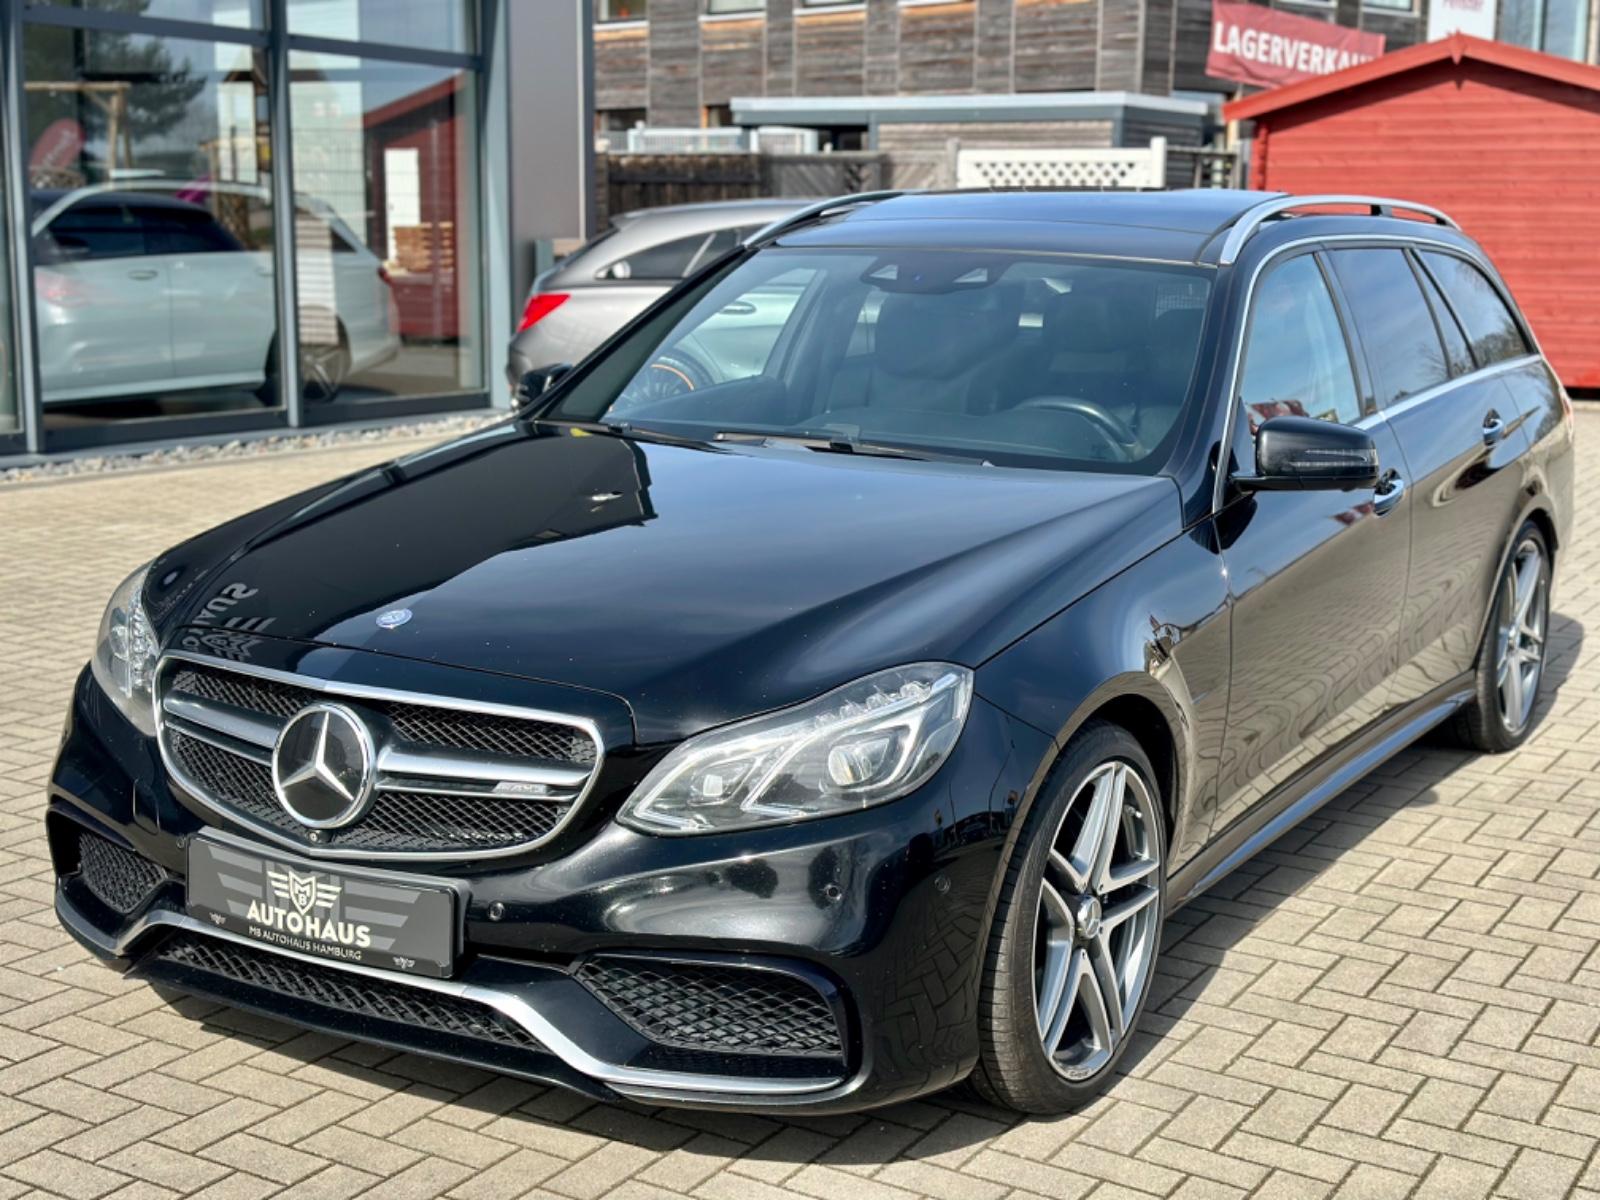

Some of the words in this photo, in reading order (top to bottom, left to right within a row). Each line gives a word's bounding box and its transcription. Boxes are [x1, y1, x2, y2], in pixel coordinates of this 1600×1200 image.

[247, 900, 371, 947] AUTOHAUS
[263, 932, 311, 949] AUTOHAUS
[313, 943, 362, 960] HAMBURG
